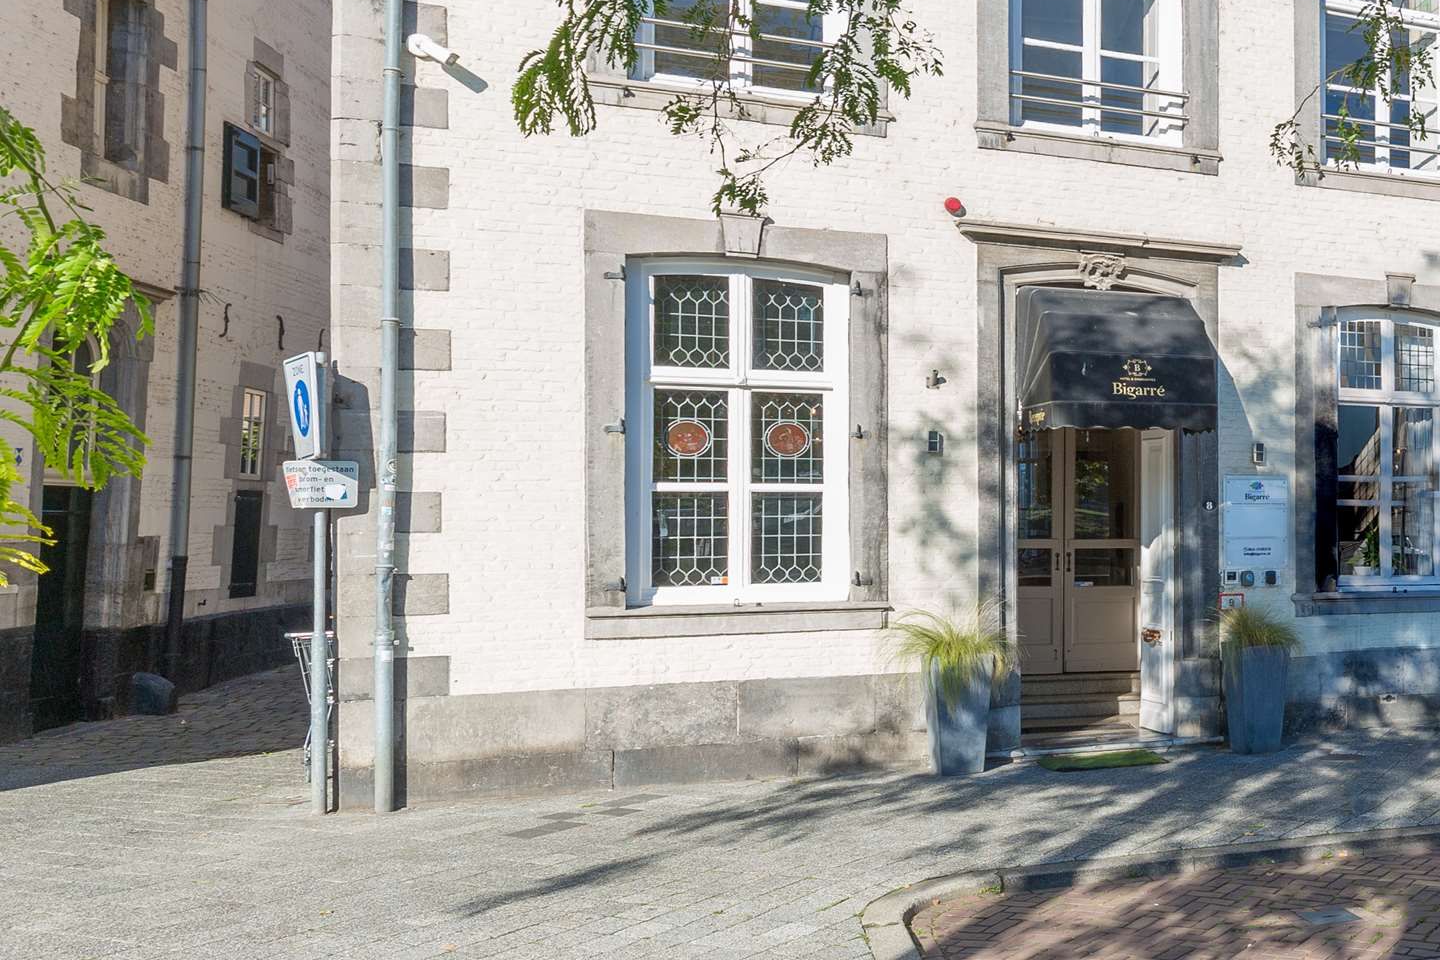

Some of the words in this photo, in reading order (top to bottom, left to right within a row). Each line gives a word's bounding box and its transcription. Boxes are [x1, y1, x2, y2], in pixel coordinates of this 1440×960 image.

[1134, 364, 1141, 372] B
[1112, 382, 1166, 399] Bigarré
[1206, 501, 1213, 510] 8
